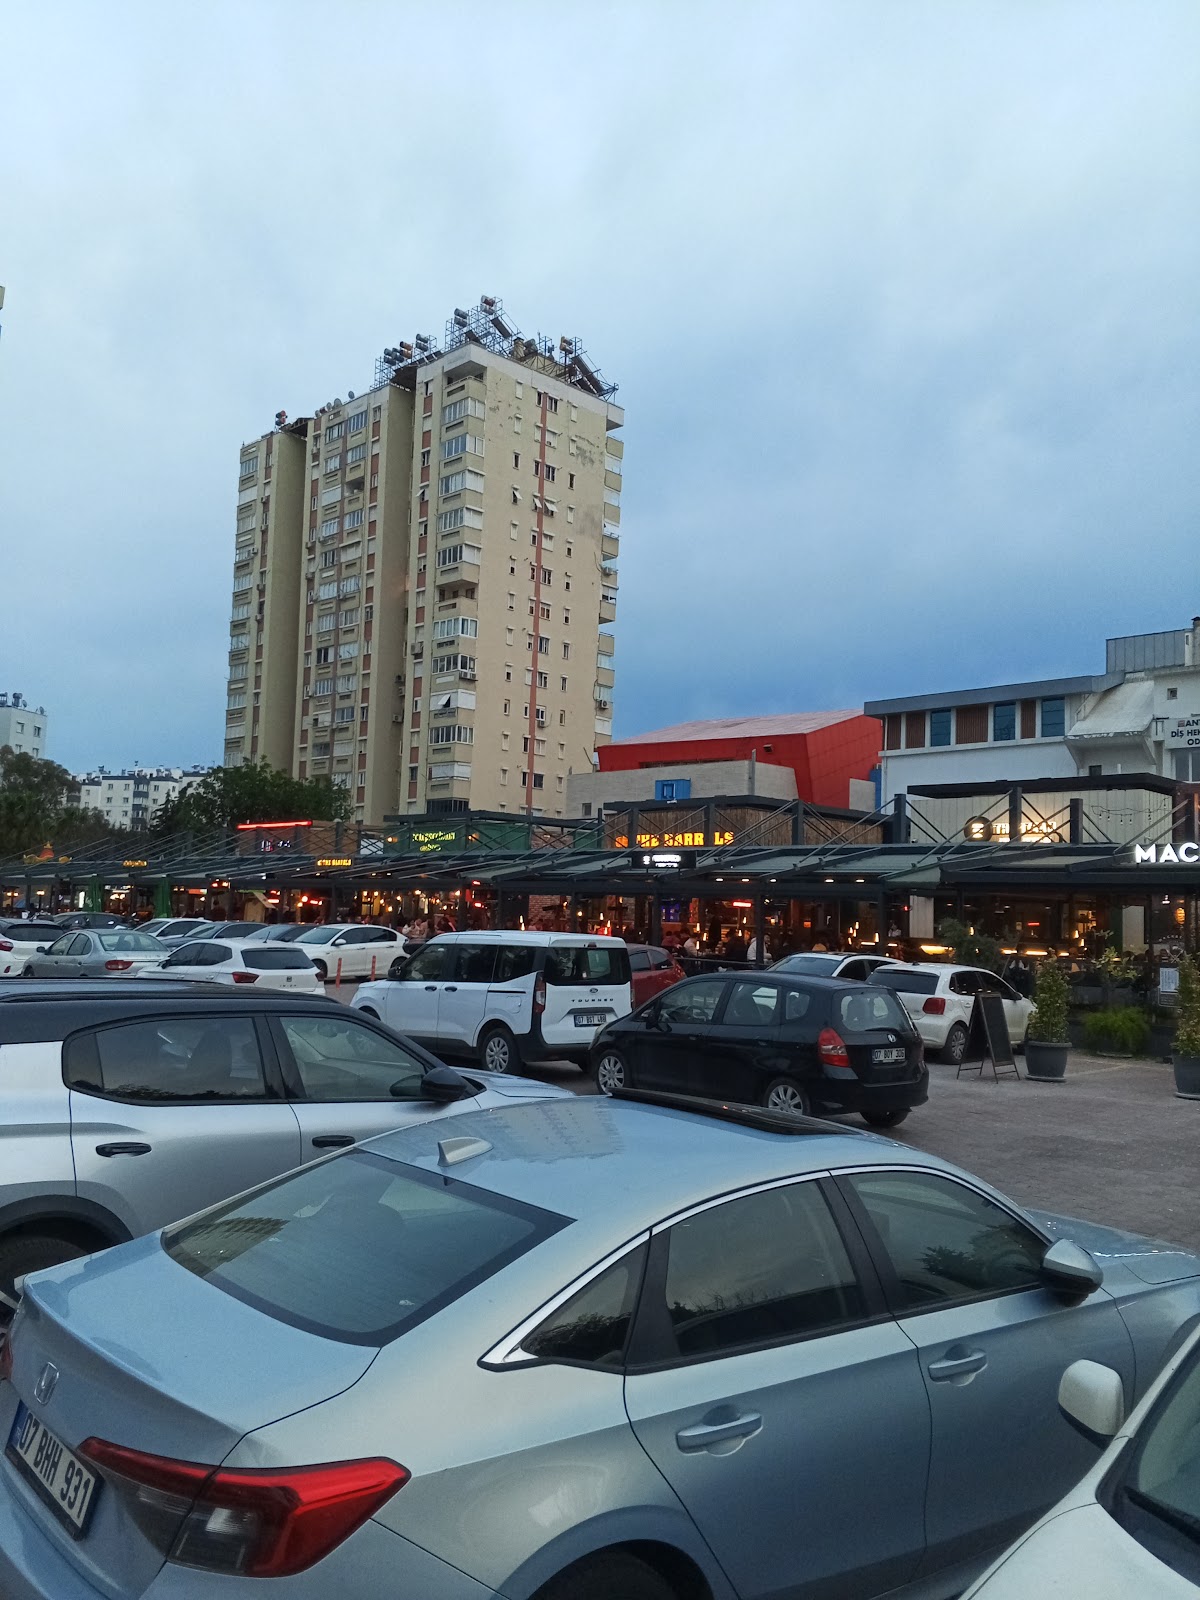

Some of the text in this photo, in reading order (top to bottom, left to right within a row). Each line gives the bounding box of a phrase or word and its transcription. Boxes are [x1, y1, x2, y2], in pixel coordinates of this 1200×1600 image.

[1186, 719, 1200, 727] AN
[1171, 728, 1185, 739] DİŞ
[664, 831, 735, 847] BARRLS
[1135, 842, 1199, 863] MAC
[577, 1016, 584, 1024] 07
[875, 1051, 881, 1059] 07
[19, 1412, 40, 1455] 07
[33, 1428, 63, 1487] BHH
[60, 1460, 90, 1519] 931
